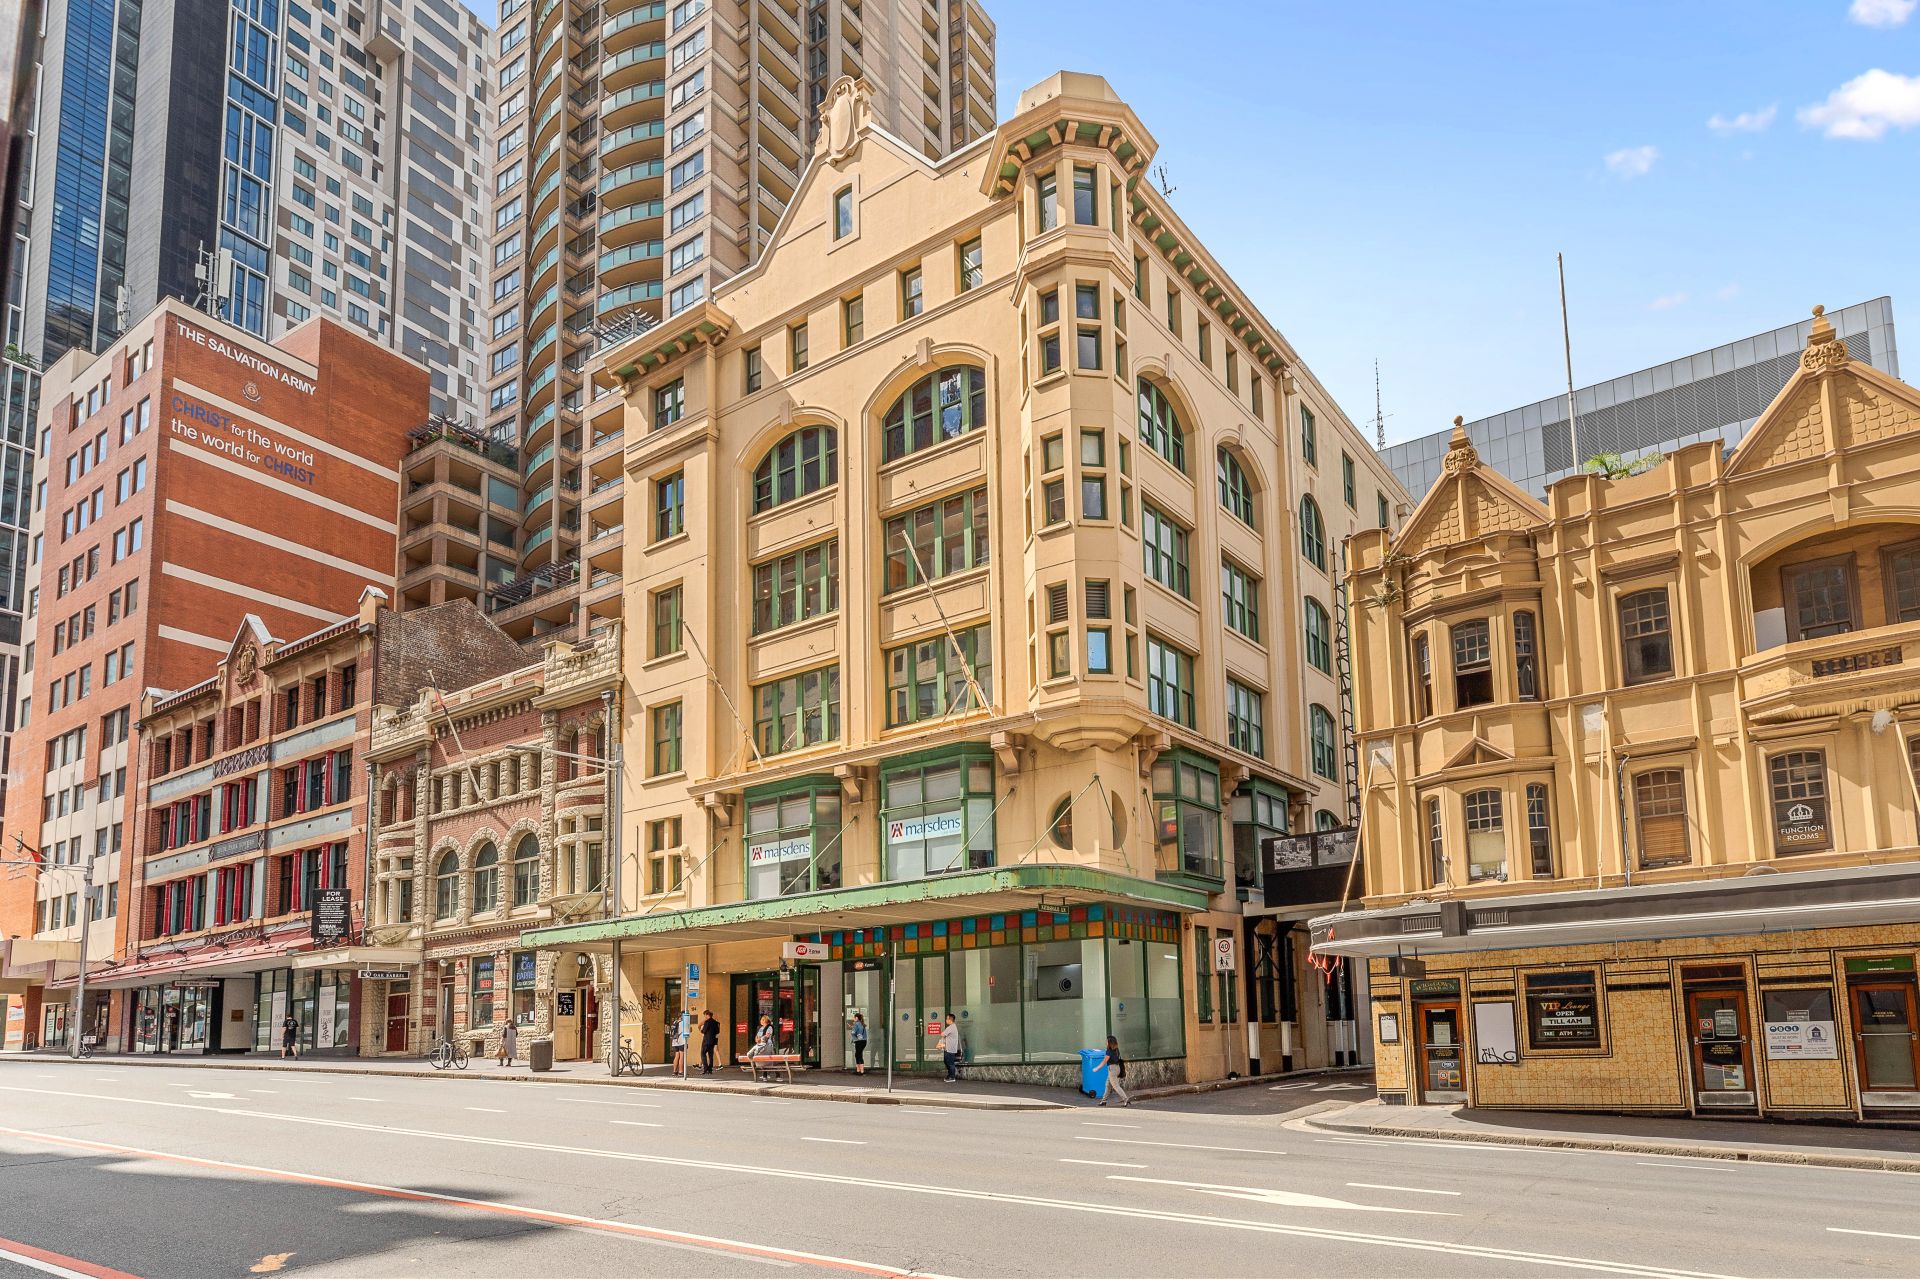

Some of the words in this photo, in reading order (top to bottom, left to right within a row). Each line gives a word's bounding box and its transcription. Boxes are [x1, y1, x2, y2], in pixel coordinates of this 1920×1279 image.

[178, 323, 205, 346] THE
[208, 338, 278, 380] SALVATION
[281, 372, 316, 396] ARMY
[172, 396, 230, 431] CHRIST
[231, 424, 245, 437] for
[248, 428, 270, 448] the
[274, 442, 314, 466] world
[172, 418, 198, 440] the
[202, 433, 243, 459] world
[246, 451, 260, 464] for
[264, 455, 315, 485] CHRIST
[905, 816, 961, 836] marsdens
[1780, 824, 1824, 834] FUNCTION
[1787, 833, 1819, 841] ROOMS
[764, 842, 810, 859] marsdens
[1561, 1002, 1590, 1011] Lounge
